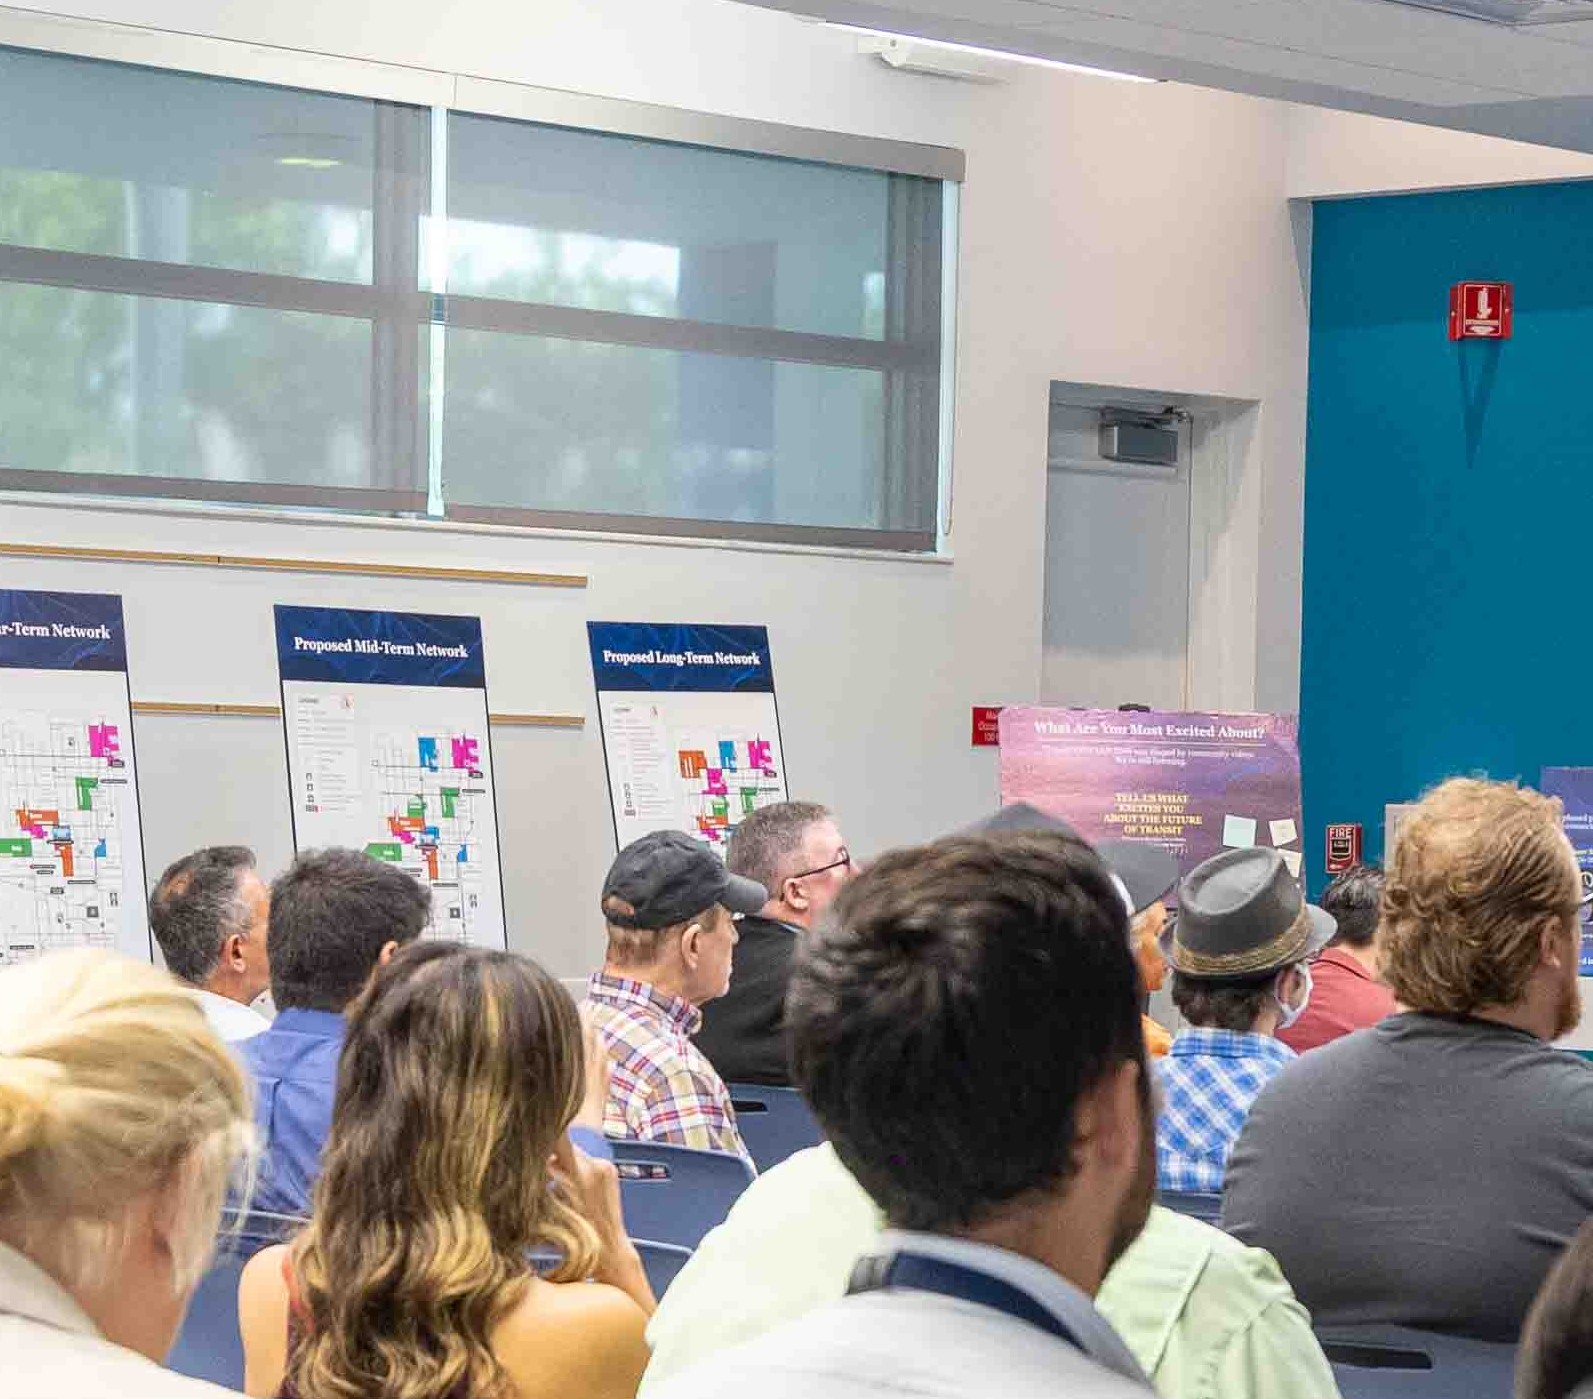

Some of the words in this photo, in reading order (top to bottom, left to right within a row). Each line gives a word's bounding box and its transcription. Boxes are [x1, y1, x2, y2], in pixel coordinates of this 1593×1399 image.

[52, 623, 112, 640] Network
[294, 636, 352, 654] Proposed
[354, 639, 415, 656] Mid-Term
[416, 643, 470, 659] Network
[603, 650, 655, 666] Proposed
[655, 651, 714, 667] Long-Term
[715, 651, 761, 666] Network
[1034, 721, 1070, 734] What
[1073, 724, 1098, 734] Are
[1099, 722, 1128, 734] You
[1129, 723, 1163, 736] Most
[1166, 724, 1215, 738] Excited
[1218, 725, 1265, 739] About?
[1157, 794, 1188, 803] WHAT
[1162, 804, 1184, 814] YOU
[1104, 814, 1137, 823] ABOUT
[1140, 814, 1161, 824] THE
[1162, 815, 1203, 825] FUTURE
[1137, 825, 1184, 835] TRANSIT
[1329, 827, 1353, 839] FIRE
